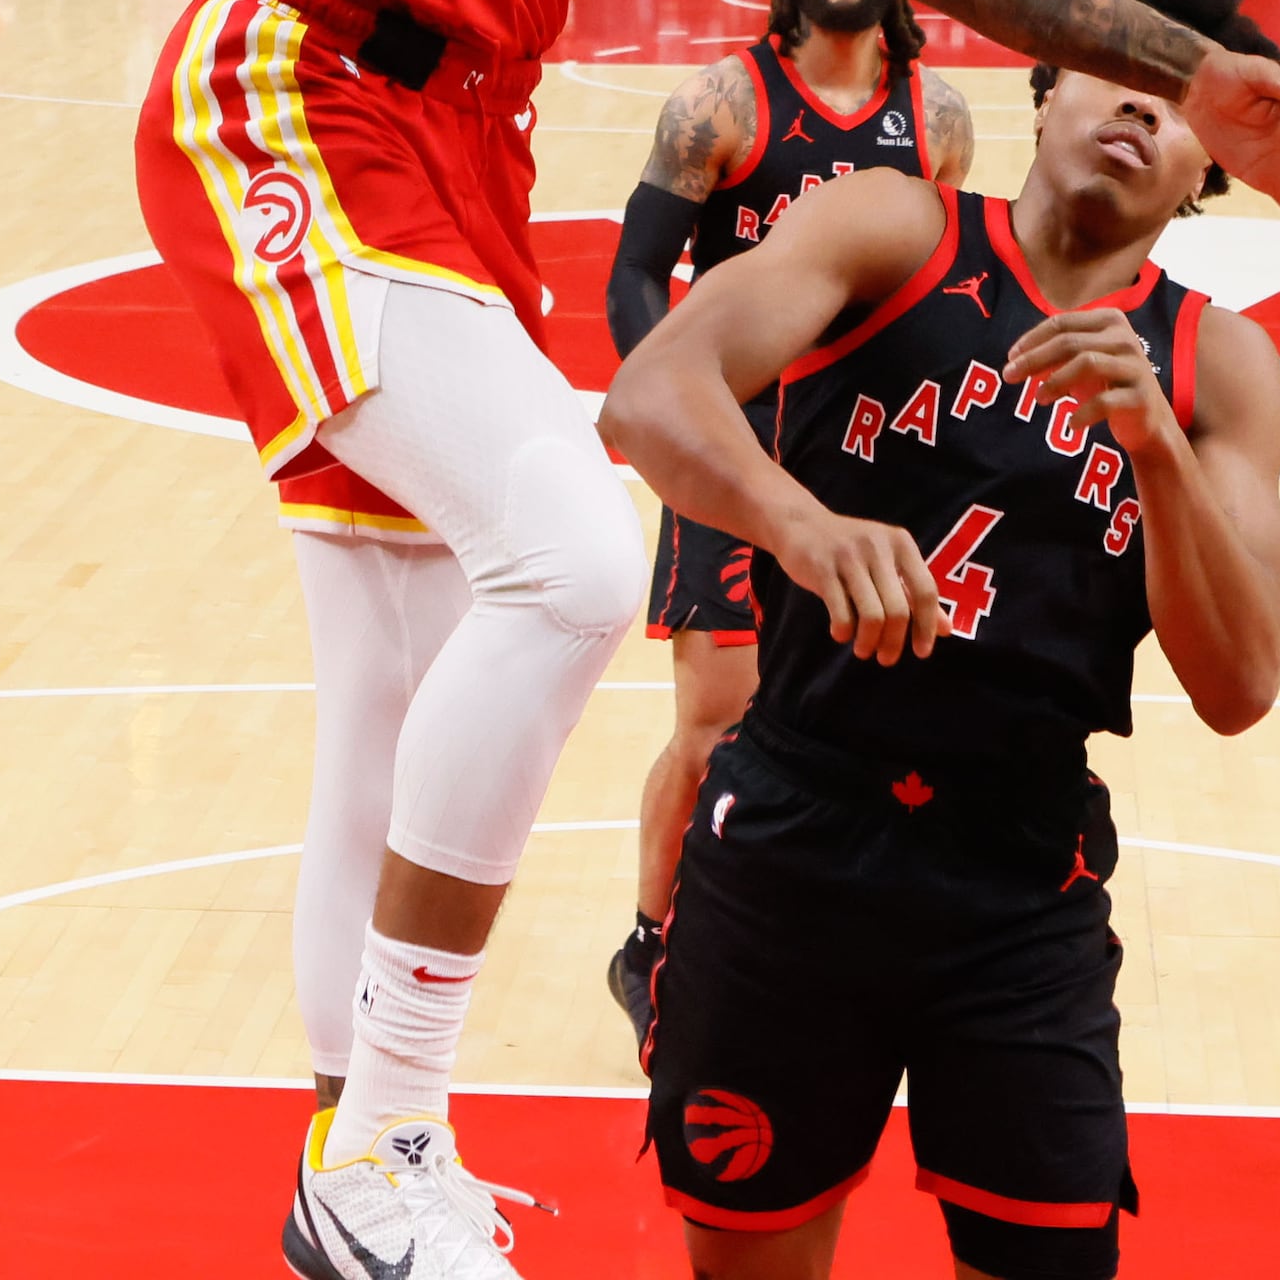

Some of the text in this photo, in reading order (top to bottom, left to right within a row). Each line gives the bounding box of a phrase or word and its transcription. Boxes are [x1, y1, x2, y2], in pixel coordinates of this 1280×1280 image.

[877, 136, 914, 148] Sun Life
[924, 504, 1005, 640] 4
